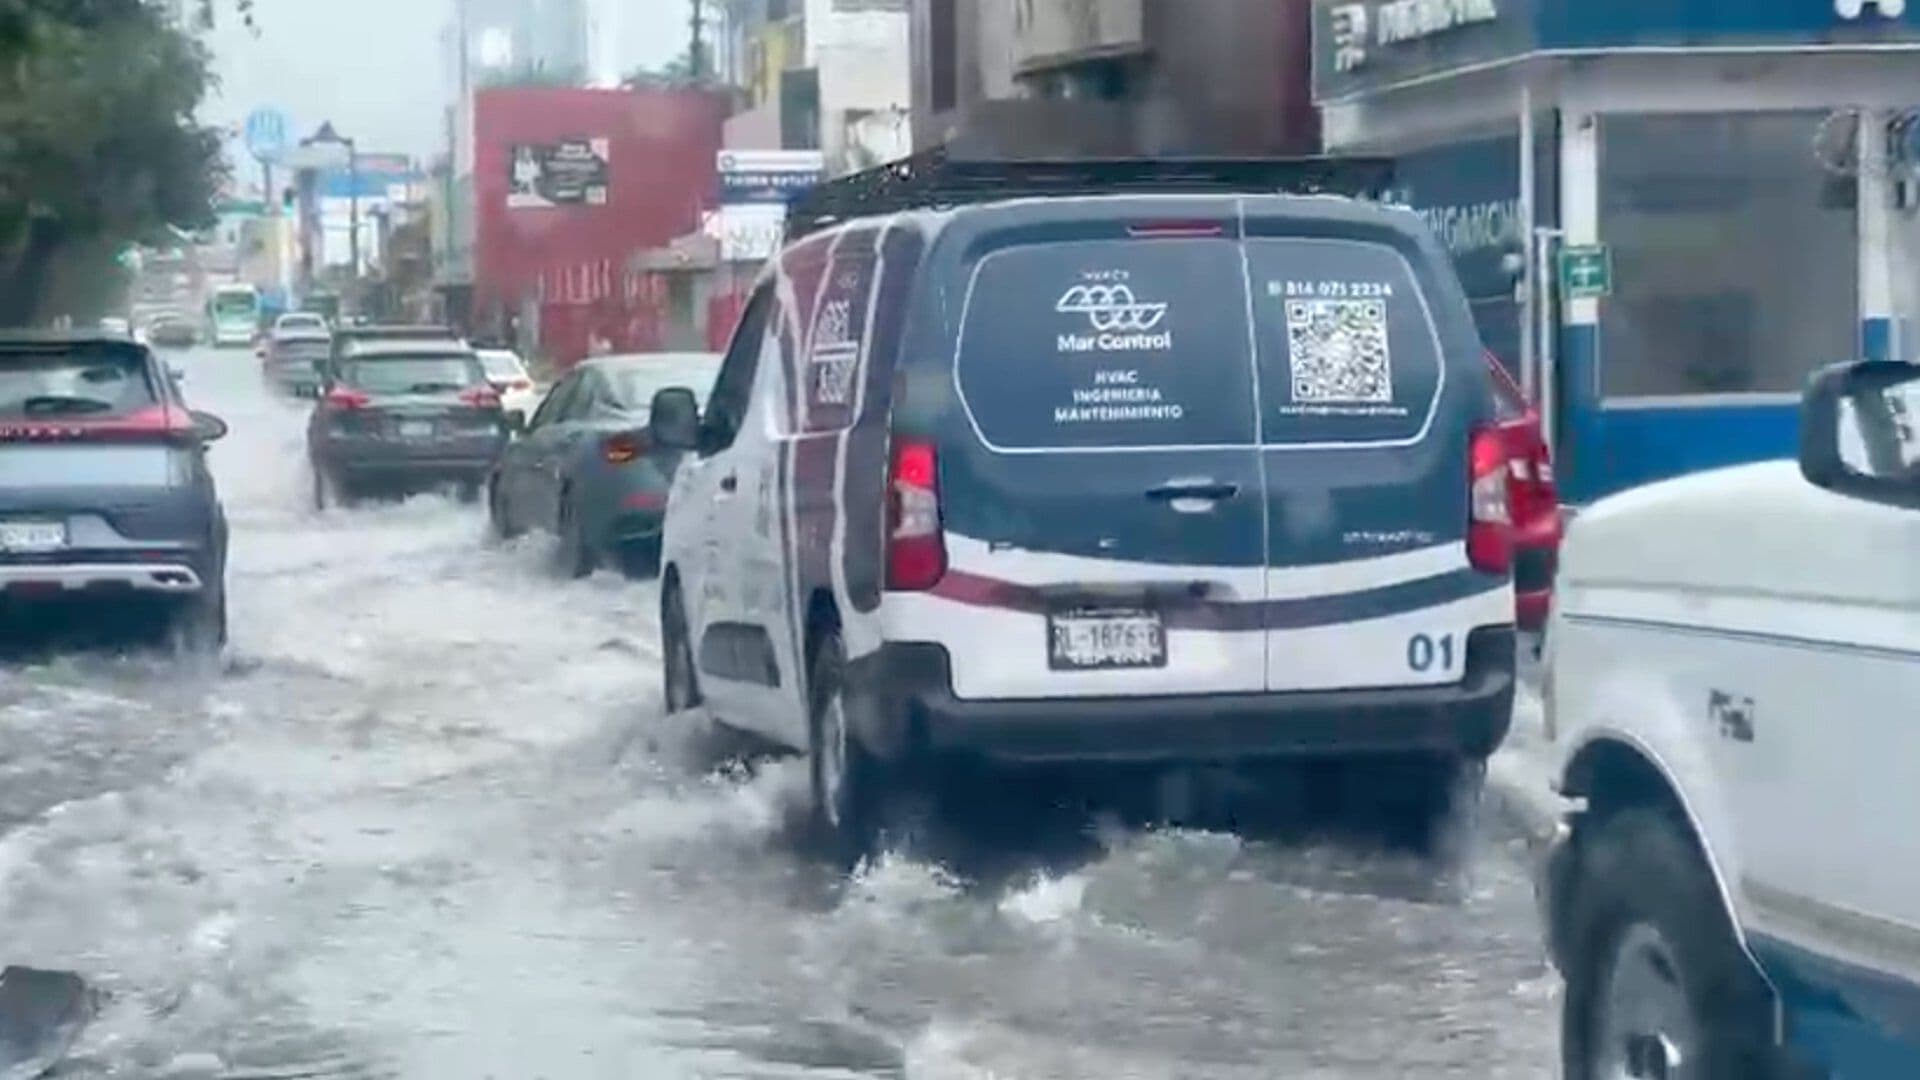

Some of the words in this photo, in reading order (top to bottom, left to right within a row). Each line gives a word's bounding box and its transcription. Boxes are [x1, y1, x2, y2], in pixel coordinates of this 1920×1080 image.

[1350, 282, 1393, 297] 2234
[1057, 334, 1095, 352] Mar
[1097, 330, 1172, 351] Control
[1094, 370, 1138, 384] HVAC
[1073, 387, 1162, 403] INGENIERIA
[1054, 404, 1184, 422] MANTENIMIENTO
[1407, 633, 1453, 672] 01
